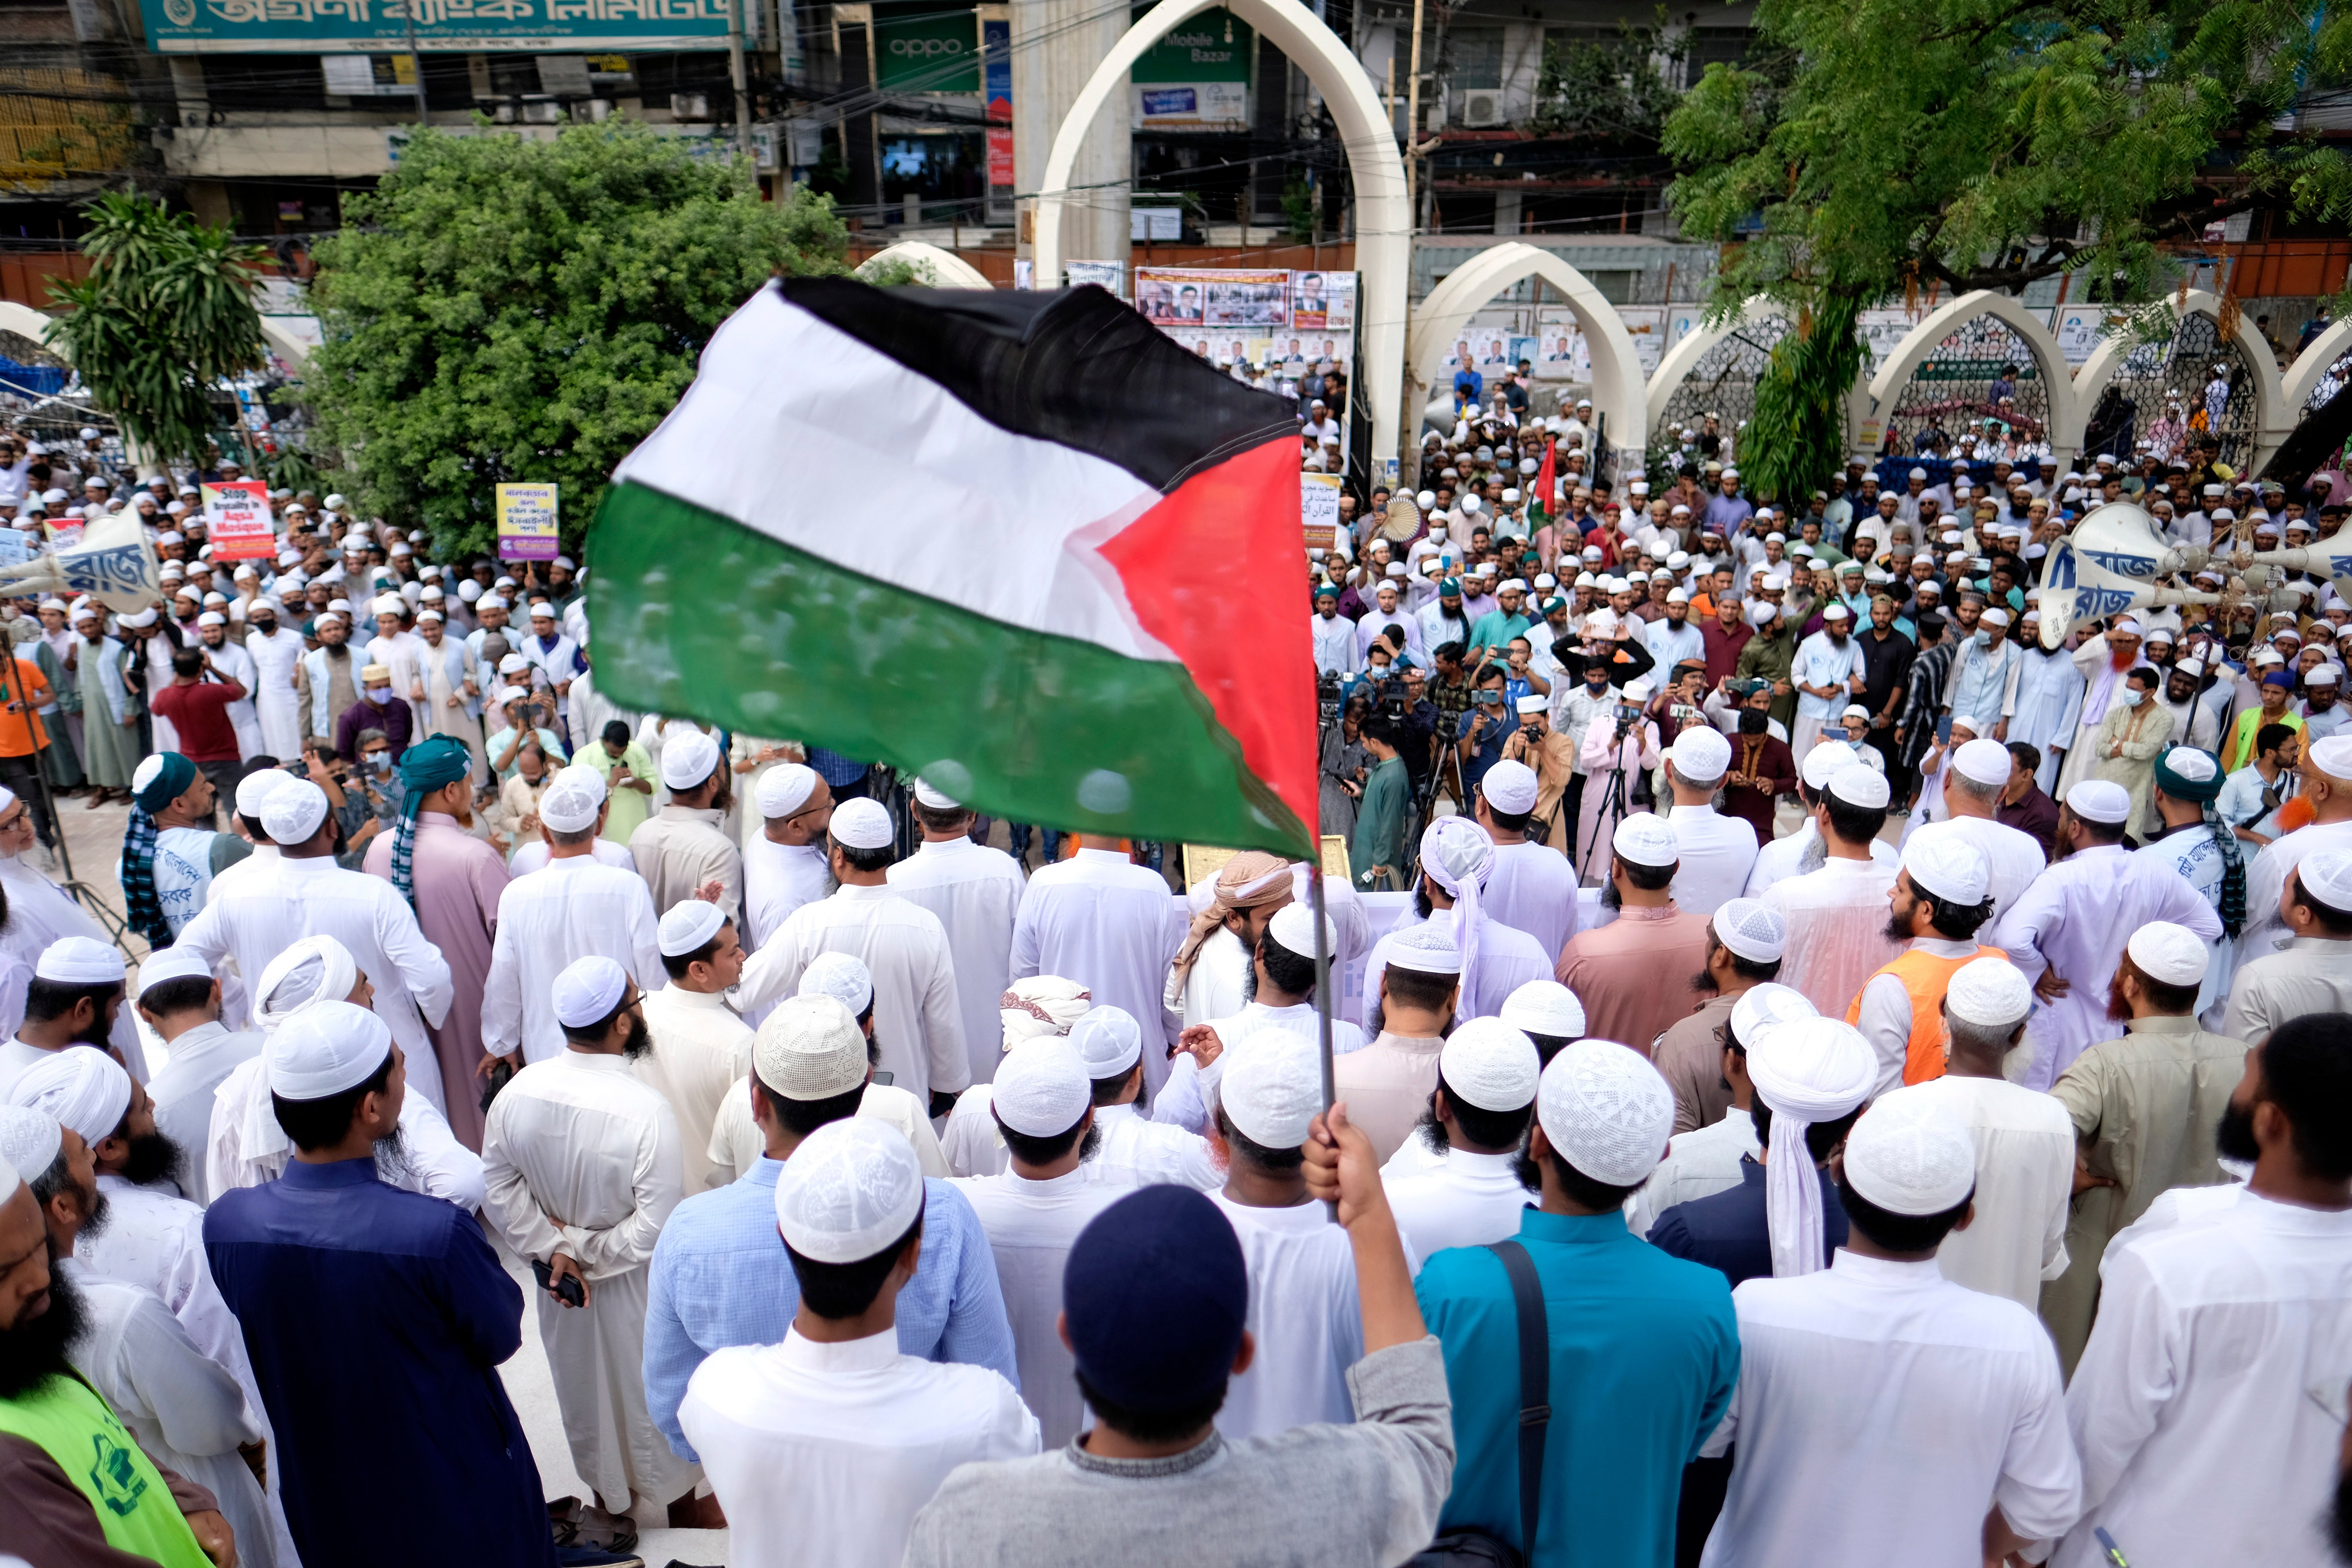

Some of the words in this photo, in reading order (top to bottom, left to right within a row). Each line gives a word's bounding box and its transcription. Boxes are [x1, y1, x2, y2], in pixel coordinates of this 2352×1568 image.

[1164, 33, 1214, 46] Mobile
[889, 38, 963, 58] oppo
[1191, 48, 1232, 62] Bazar
[221, 488, 248, 499] Stop
[224, 511, 254, 522] Aqsa
[1312, 504, 1334, 517] القرآن
[216, 523, 265, 534] Mosque
[2074, 583, 2137, 620] রাজ
[164, 849, 202, 885] বাংলাদেশ
